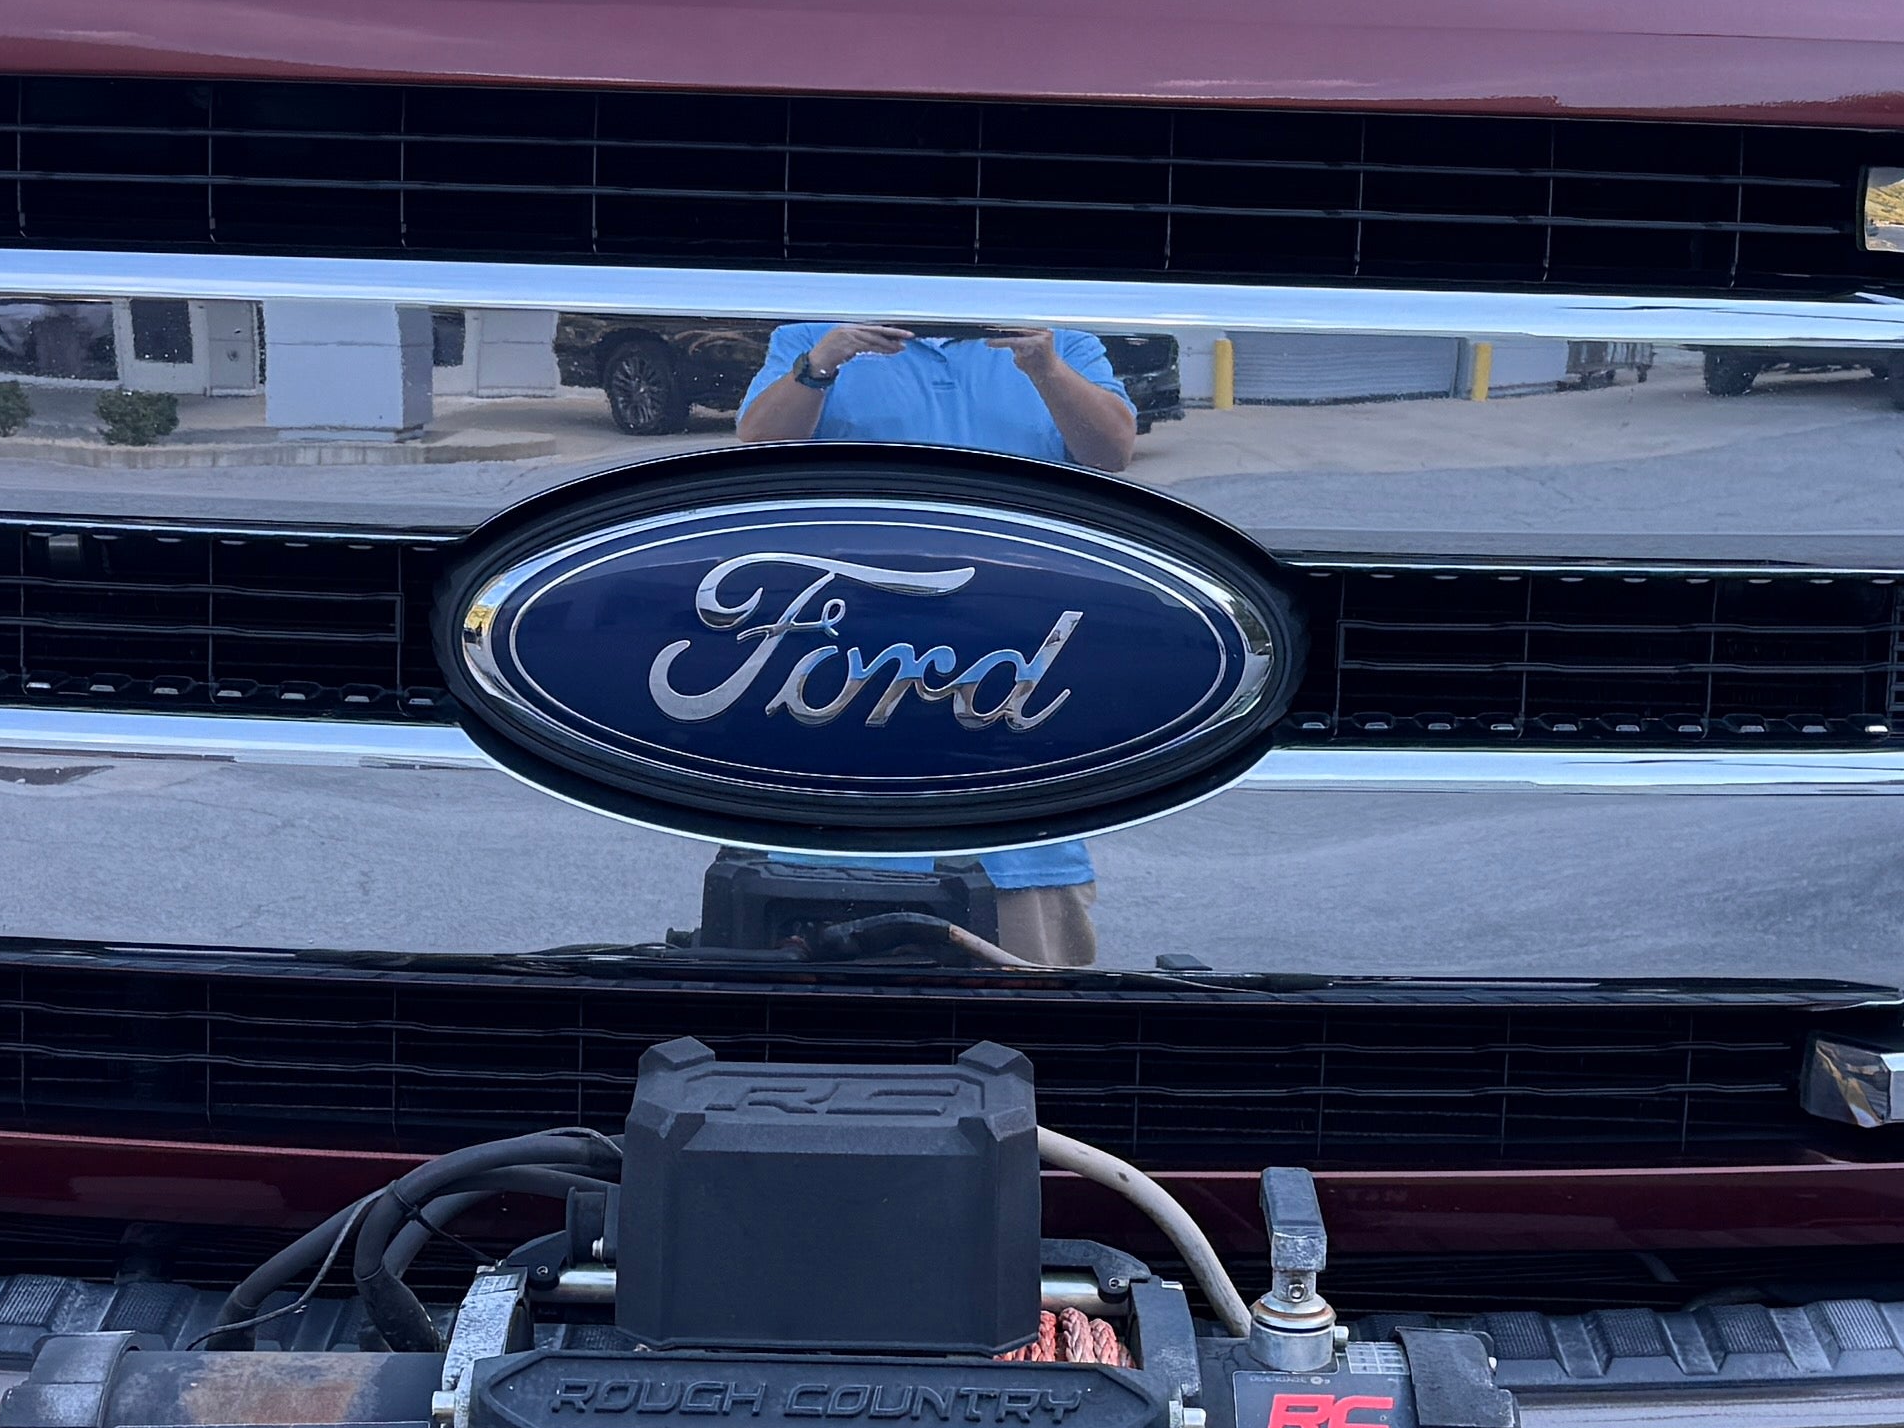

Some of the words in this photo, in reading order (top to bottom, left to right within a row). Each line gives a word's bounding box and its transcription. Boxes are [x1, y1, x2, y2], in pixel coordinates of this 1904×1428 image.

[647, 551, 1085, 731] Ford
[549, 1377, 769, 1416] ROUGH
[783, 1381, 1086, 1426] COUNTRY
